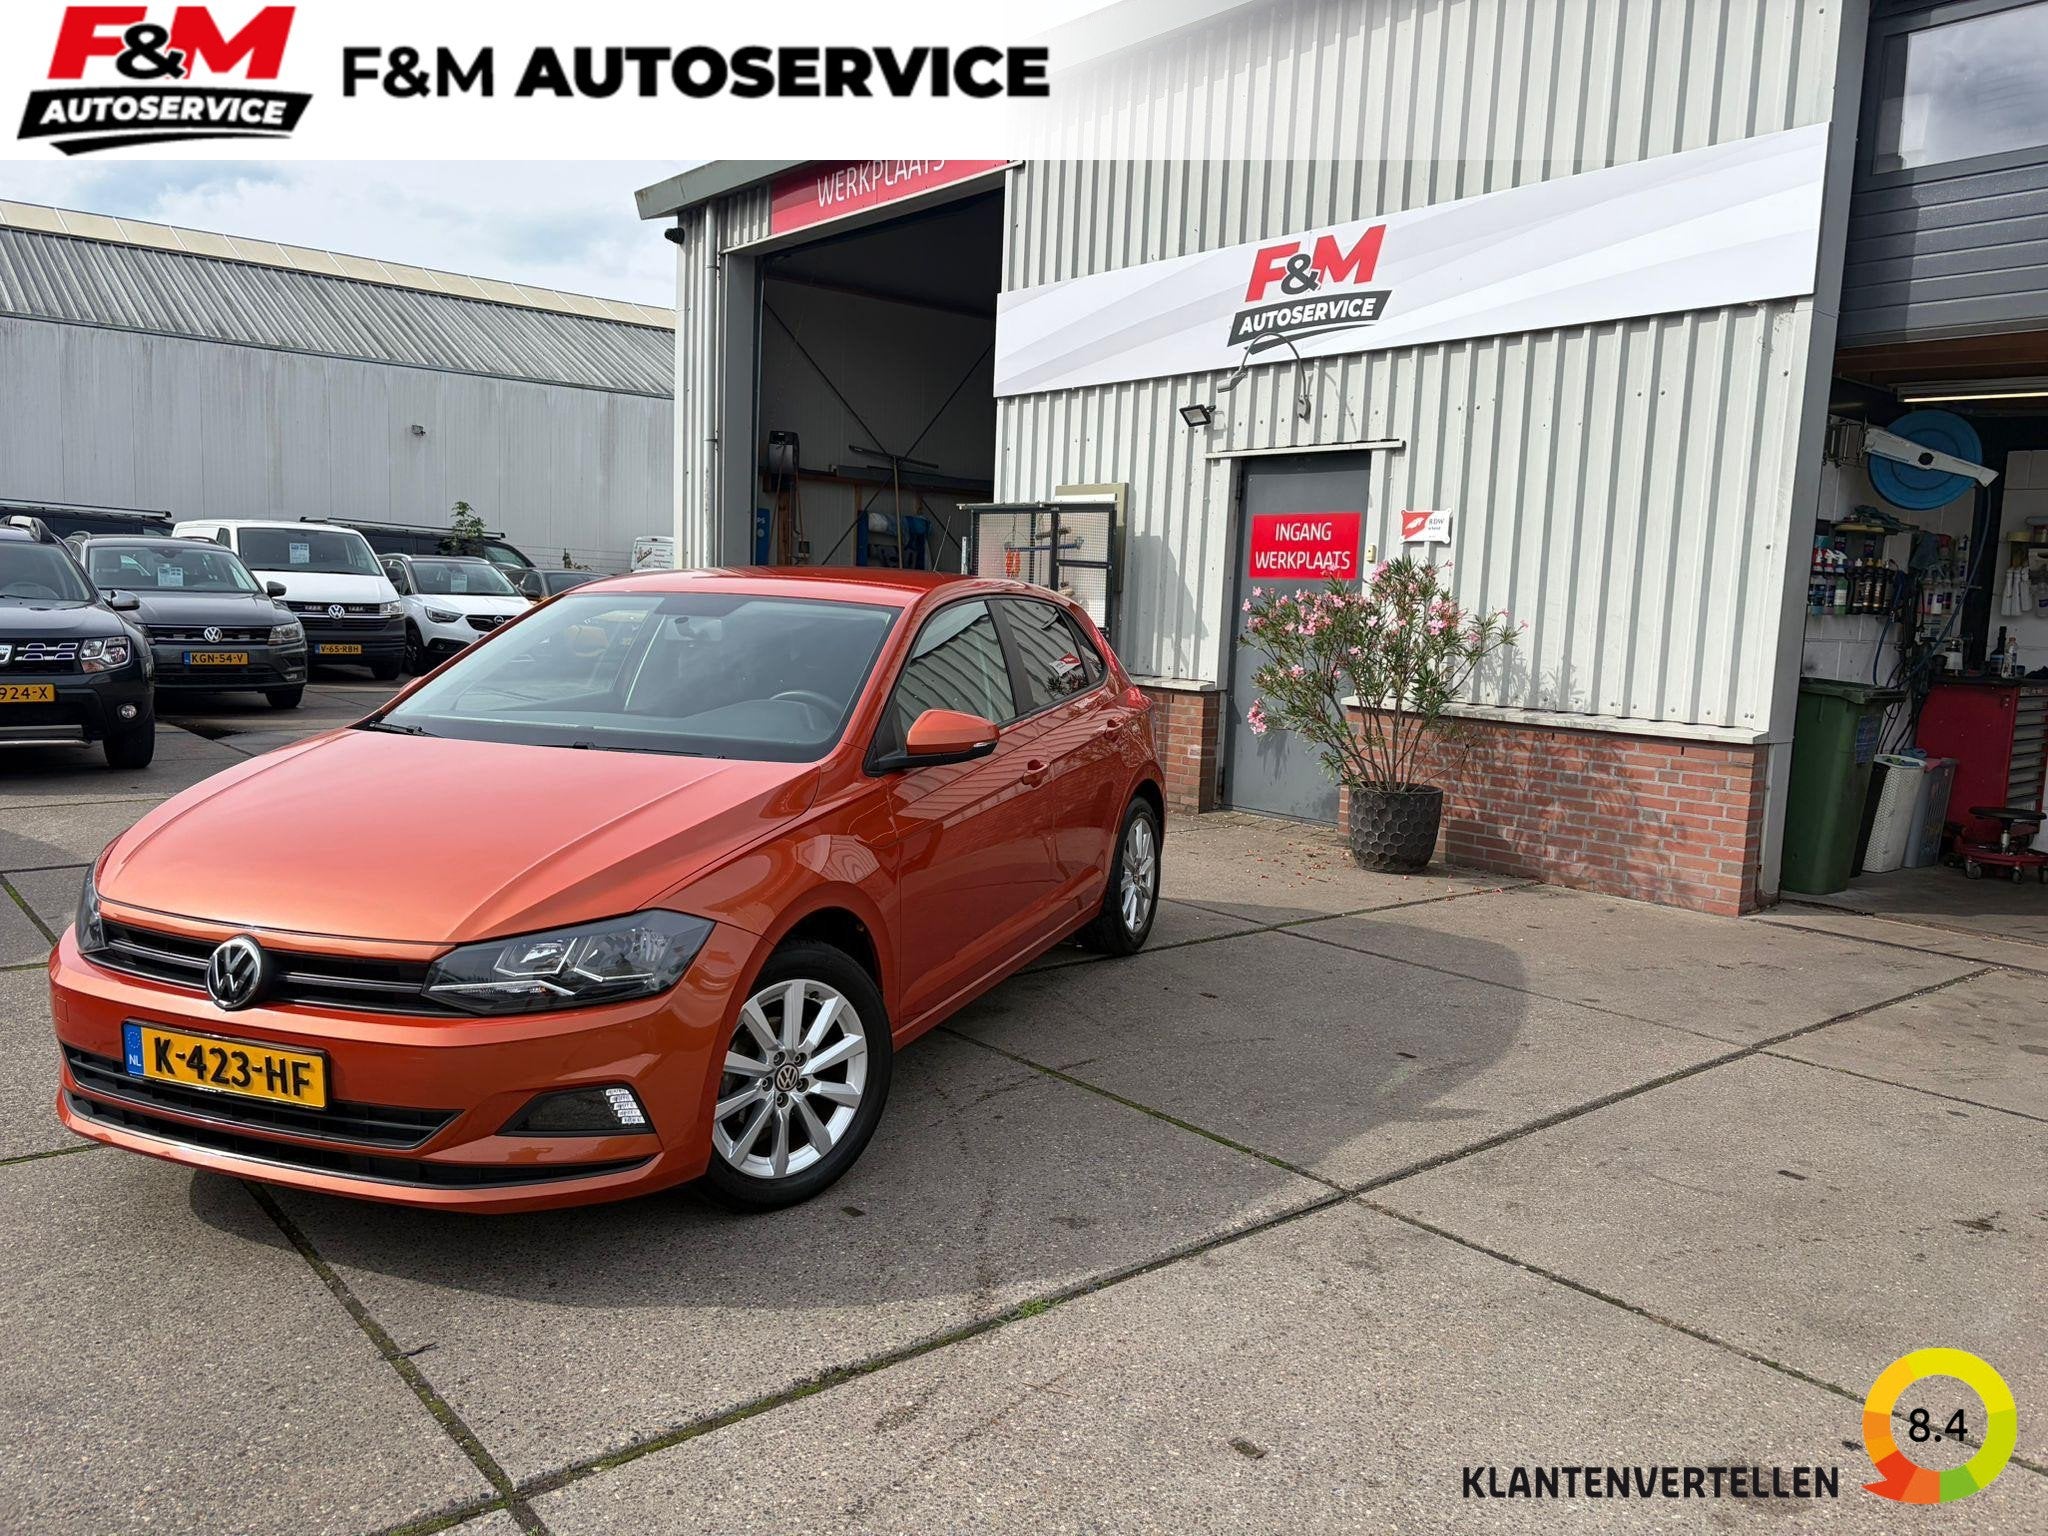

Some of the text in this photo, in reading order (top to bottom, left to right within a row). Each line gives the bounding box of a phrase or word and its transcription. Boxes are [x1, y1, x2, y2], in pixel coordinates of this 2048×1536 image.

[1245, 224, 1387, 302] F&M
[1238, 297, 1377, 336] AUTOSERVICE
[1275, 522, 1332, 541] INGANG
[1255, 550, 1350, 569] WERKPLAATS
[191, 654, 243, 663] KGN-54-V
[0, 686, 48, 700] 924-X
[129, 1054, 142, 1067] NL
[154, 1036, 311, 1097] K-423-HF
